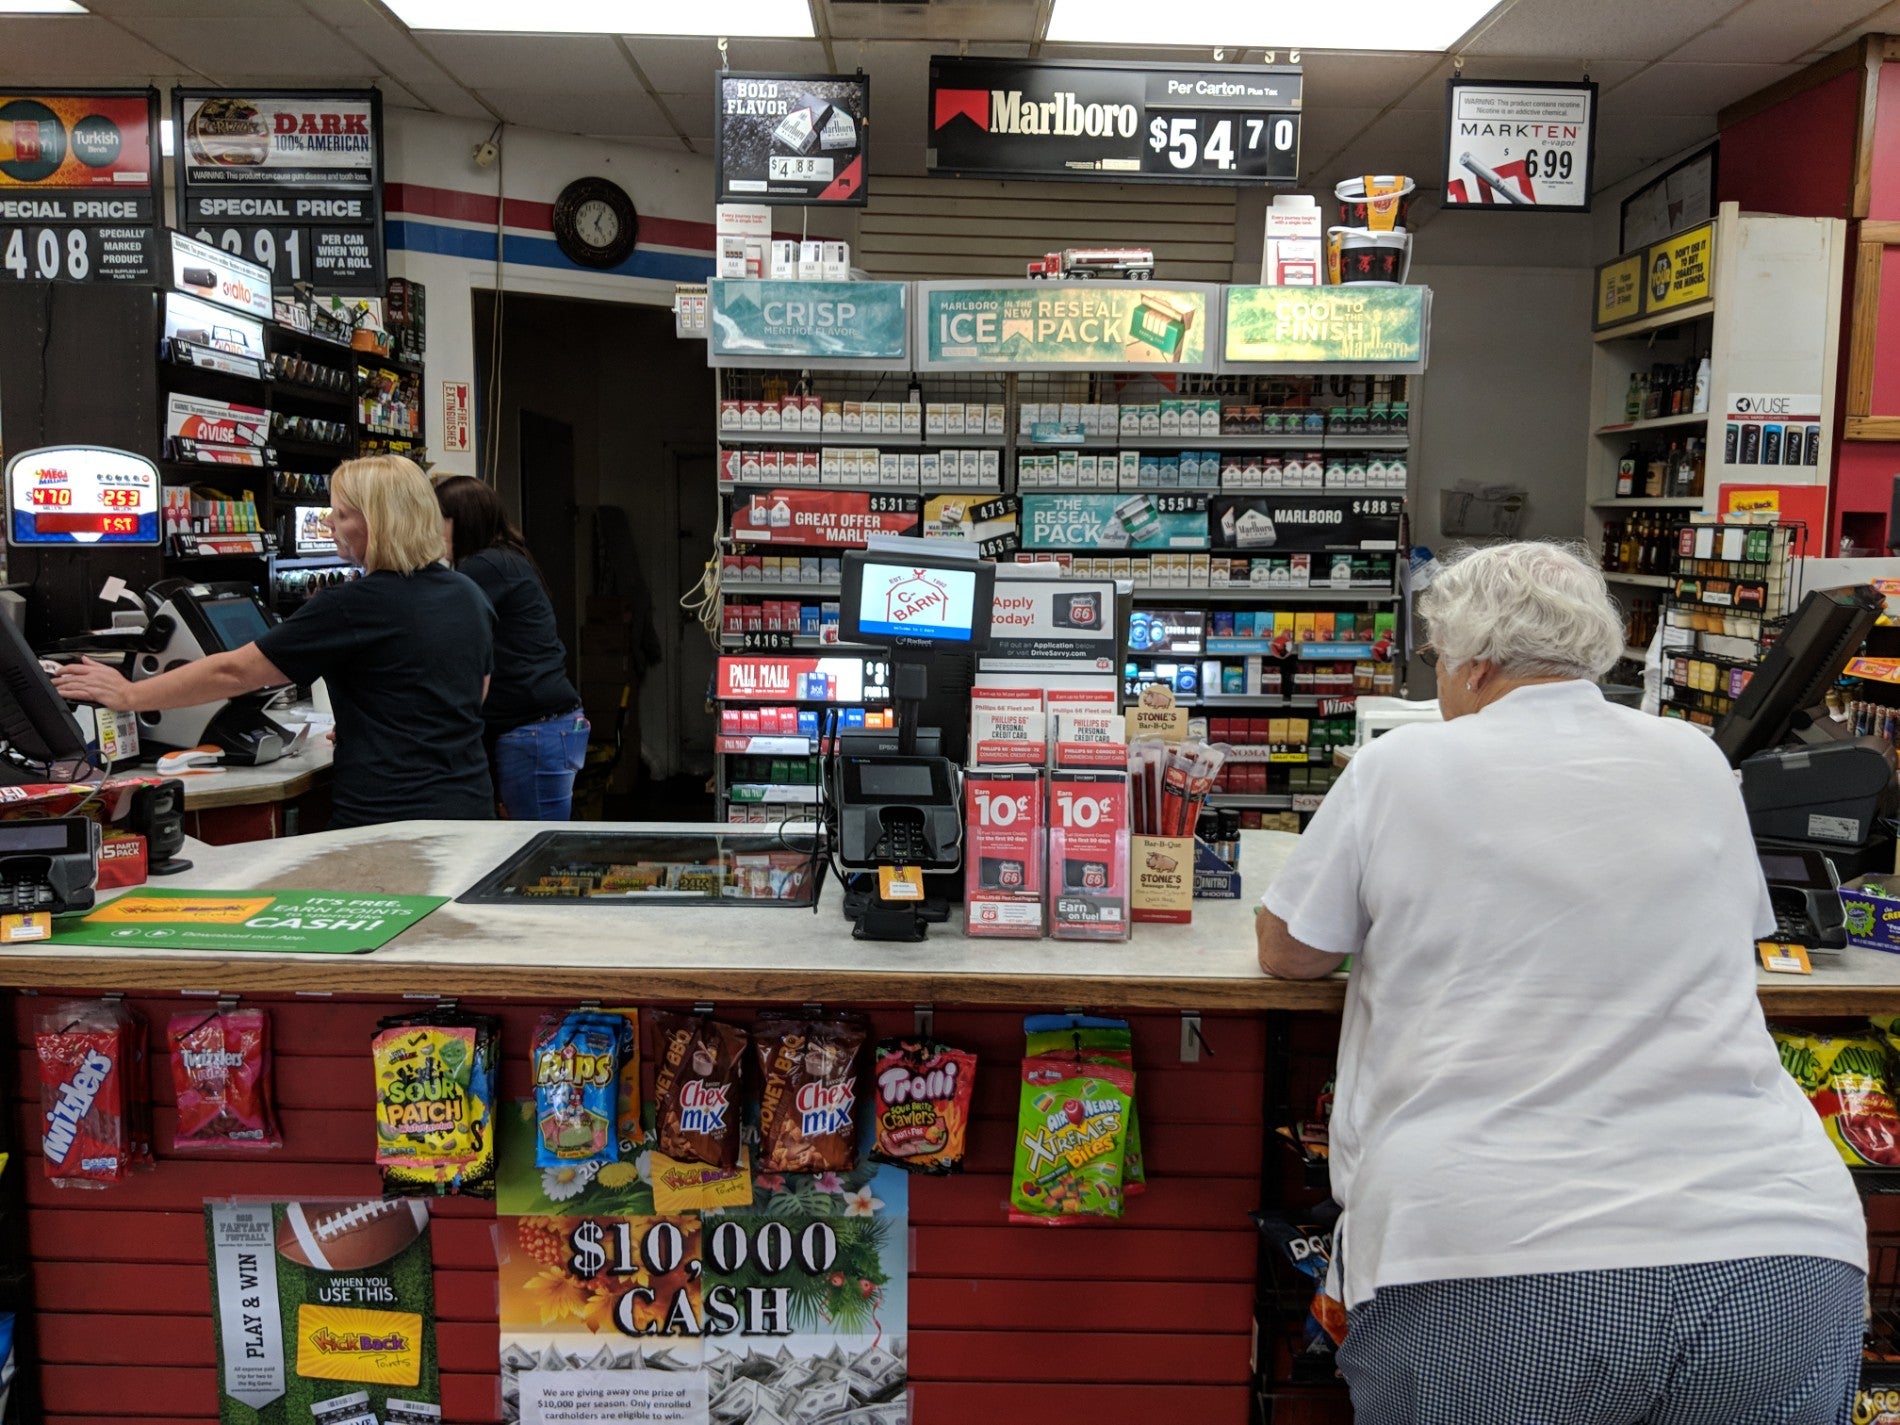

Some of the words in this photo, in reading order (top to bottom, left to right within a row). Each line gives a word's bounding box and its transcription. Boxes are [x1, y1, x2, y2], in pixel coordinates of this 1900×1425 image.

[738, 83, 778, 98] BOLD
[1168, 80, 1193, 94] Per
[1196, 81, 1245, 95] Carton
[1264, 88, 1278, 96] Tax
[727, 100, 788, 115] FLAVOR
[1510, 100, 1532, 108] product
[990, 90, 1138, 138] Marlboro
[274, 114, 368, 134] DARK
[1461, 123, 1577, 139] MARKTEN
[75, 131, 119, 145] Turkish
[275, 136, 304, 151] 100%
[307, 136, 369, 152] AMERICAN
[1526, 149, 1572, 179] 6.99
[193, 171, 225, 180] WARNING:
[226, 172, 238, 180] This
[238, 172, 261, 181] product
[339, 173, 353, 181] tooth
[73, 202, 138, 218] PRICE
[200, 200, 289, 216] SPECIAL
[297, 200, 361, 218] PRICE
[104, 242, 141, 250] MARKED
[322, 235, 341, 245] PER
[344, 235, 364, 245] CAN
[103, 255, 143, 263] PRODUCT
[318, 247, 348, 257] WHEN
[350, 247, 369, 257] YOU
[316, 258, 336, 268] BUY
[338, 258, 345, 268] A
[347, 258, 372, 269] ROLL
[940, 302, 998, 310] MARLBORO
[1016, 301, 1032, 309] THE
[1038, 301, 1122, 318] RESEAL
[1275, 303, 1344, 321] COOL
[1346, 304, 1364, 313] TO
[763, 302, 856, 327] CRISP
[1003, 308, 1032, 318] NEW
[1345, 313, 1363, 321] THE
[764, 326, 812, 336] MENTHOL
[816, 327, 856, 337] FLAVOR
[939, 313, 998, 344] ICE
[1038, 319, 1123, 344] PACK
[1275, 322, 1363, 341] FINISH
[1750, 398, 1790, 414] VUSE
[445, 385, 457, 447] EXTINGUISHER
[459, 407, 467, 428] FIRE
[40, 468, 68, 479] MEGA
[1054, 499, 1082, 511] THE
[795, 512, 837, 526] GREAT
[840, 514, 881, 528] OFFER
[1034, 511, 1101, 524] RESEAL
[1275, 509, 1342, 524] MARLBORO
[1034, 524, 1101, 543] PACK
[893, 592, 941, 621] BARN
[993, 596, 1034, 610] Apply
[991, 613, 1035, 627] today!
[1072, 608, 1090, 619] 66
[729, 664, 756, 687] PALL
[760, 664, 790, 688] MALL
[992, 716, 1017, 724] PHILLIPS
[1074, 719, 1099, 727] PHILLIPS
[1137, 712, 1177, 722] STONIE'S
[996, 724, 1024, 732] PERSONAL
[1139, 722, 1175, 730] Bar-B-Que
[116, 842, 140, 850] PARTY
[1144, 840, 1181, 848] Bar-B-Que
[116, 849, 139, 857] PACK
[1003, 872, 1017, 883] 66
[1087, 875, 1101, 884] 66
[1141, 874, 1181, 883] STONIE'S
[306, 898, 346, 906] IT'S
[1058, 902, 1087, 912] Earn
[272, 905, 325, 913] EARN
[337, 907, 413, 916] POINTS
[1081, 912, 1099, 920] fuel
[245, 917, 384, 931] CASH!
[667, 1029, 692, 1065] BBQ
[181, 1049, 244, 1067] Twizzlers
[537, 1049, 612, 1086] Rips
[878, 1061, 957, 1103] Trolli
[389, 1080, 457, 1102] SOUR
[680, 1080, 731, 1108] Chex
[797, 1078, 856, 1111] Chex
[387, 1100, 463, 1126] PATCH
[680, 1106, 727, 1133] mix
[802, 1102, 853, 1135] mix
[882, 1110, 936, 1130] Crawlers
[1047, 1111, 1069, 1133] AIR
[1081, 1099, 1122, 1116] HEADS
[1024, 1115, 1120, 1173] XTREMES
[1066, 1135, 1115, 1167] bites
[219, 1223, 270, 1233] FANTASY
[225, 1233, 266, 1242] FOOTBALL
[570, 1220, 837, 1281] $10,000
[238, 1253, 257, 1290] WIN
[330, 1278, 362, 1287] WHEN
[365, 1278, 388, 1287] YOU
[319, 1288, 351, 1301] USE
[355, 1287, 399, 1301] THIS.
[242, 1298, 260, 1308] &
[614, 1286, 792, 1337] CASH
[243, 1314, 264, 1358] PLAY
[543, 1389, 558, 1397] We
[577, 1389, 604, 1398] giving
[606, 1389, 629, 1397] away
[652, 1389, 673, 1399] prize
[676, 1388, 686, 1397] of
[538, 1401, 574, 1409] $10,000
[576, 1402, 590, 1410] per
[631, 1400, 650, 1409] Only
[545, 1412, 598, 1420] cardholders
[618, 1411, 650, 1422] eligible
[652, 1412, 662, 1420] to
[665, 1412, 684, 1420] win.
